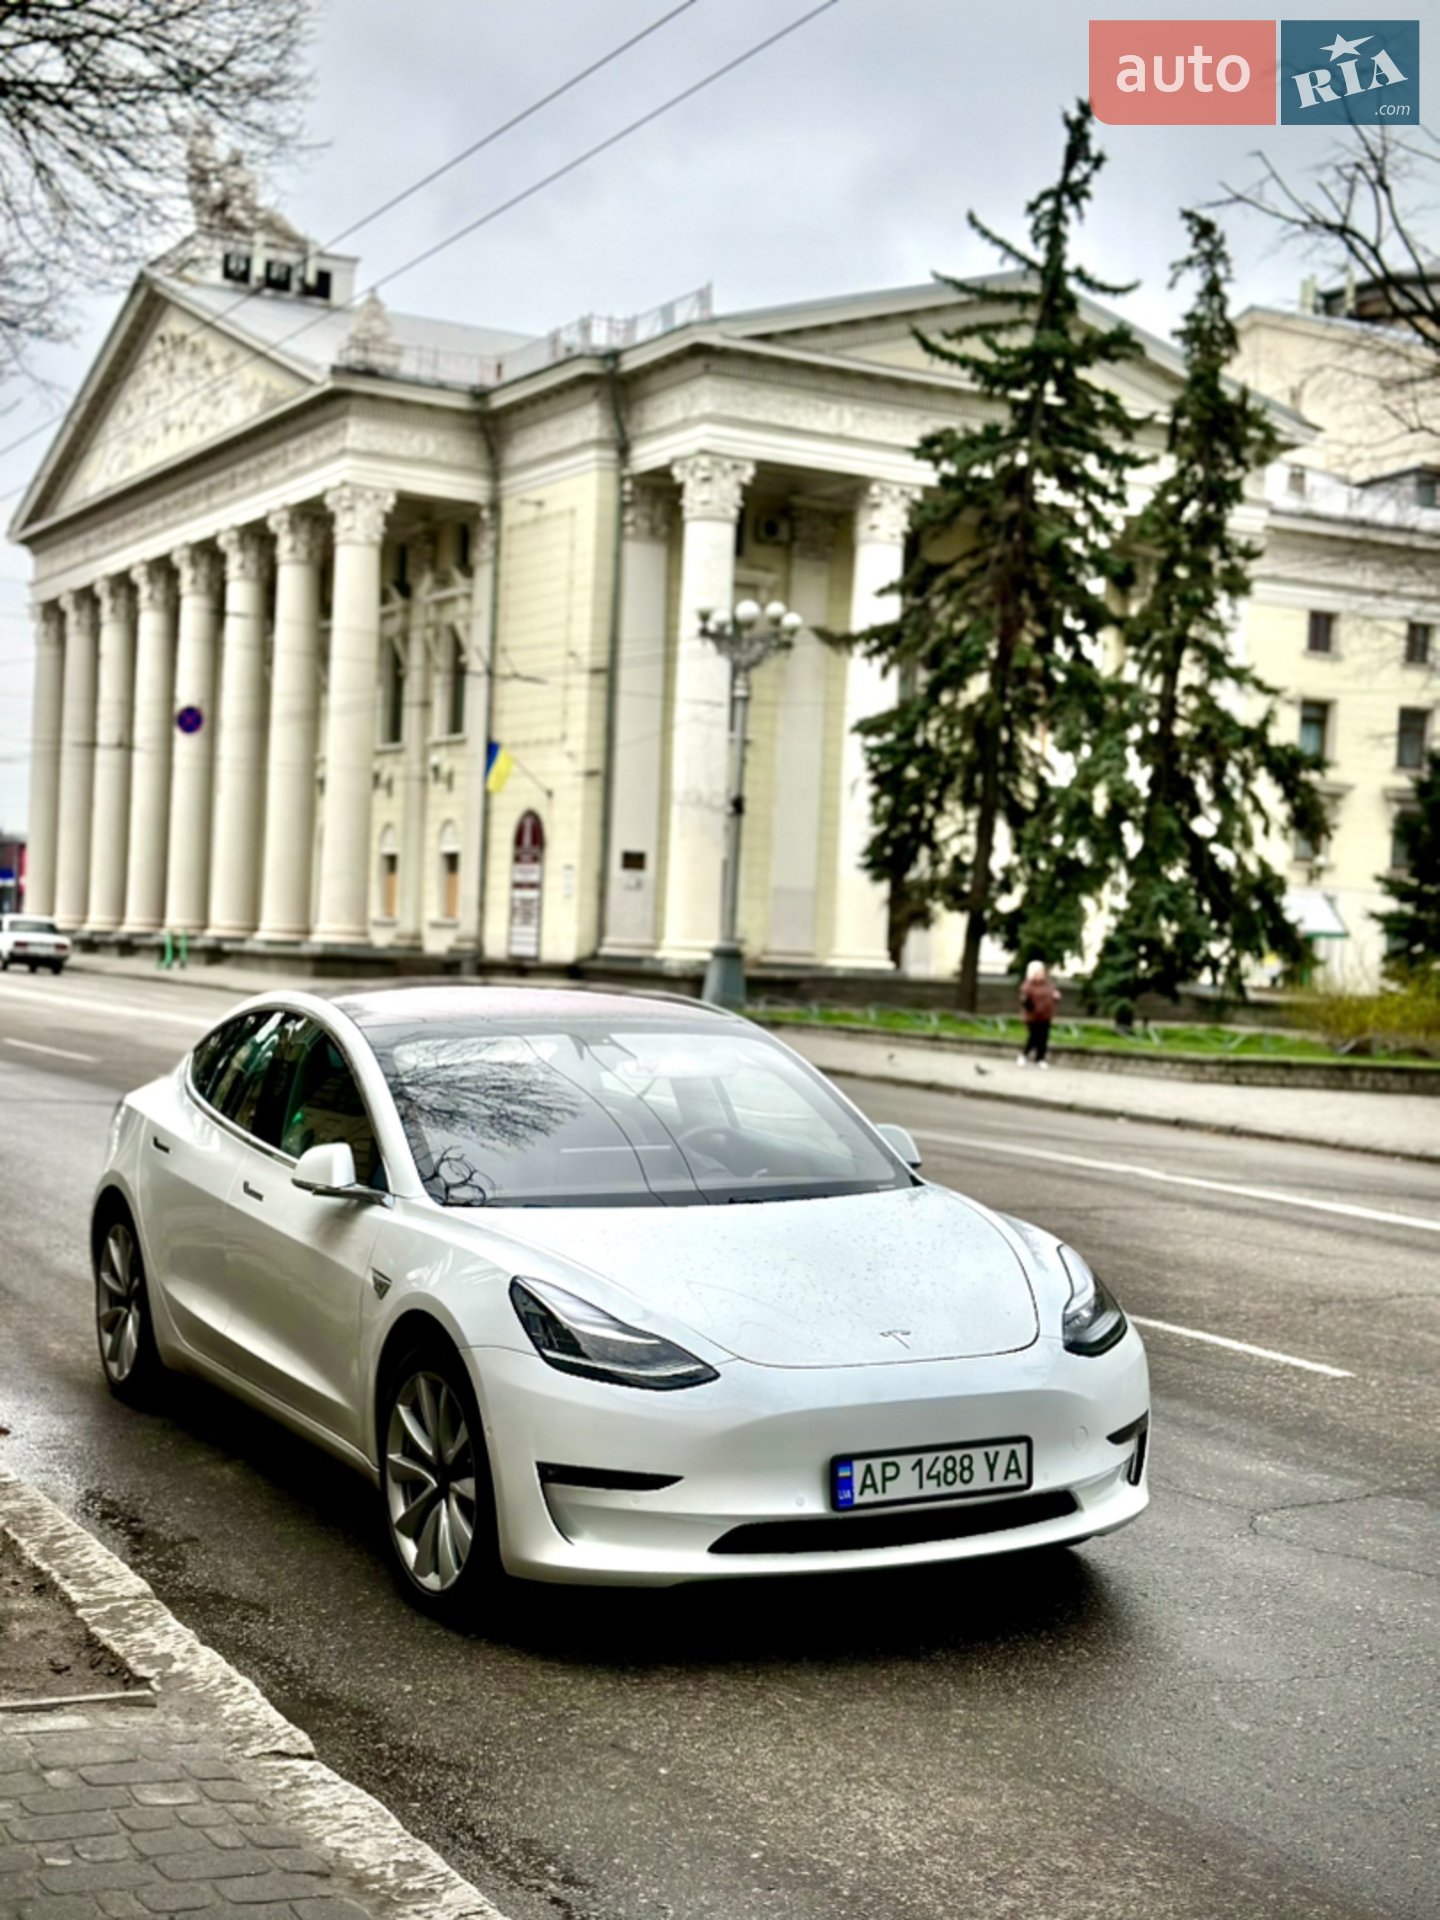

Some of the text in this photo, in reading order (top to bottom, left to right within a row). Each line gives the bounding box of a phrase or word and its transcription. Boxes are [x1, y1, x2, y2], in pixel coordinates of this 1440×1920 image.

[859, 1449, 1023, 1496] AP 1488 YA
